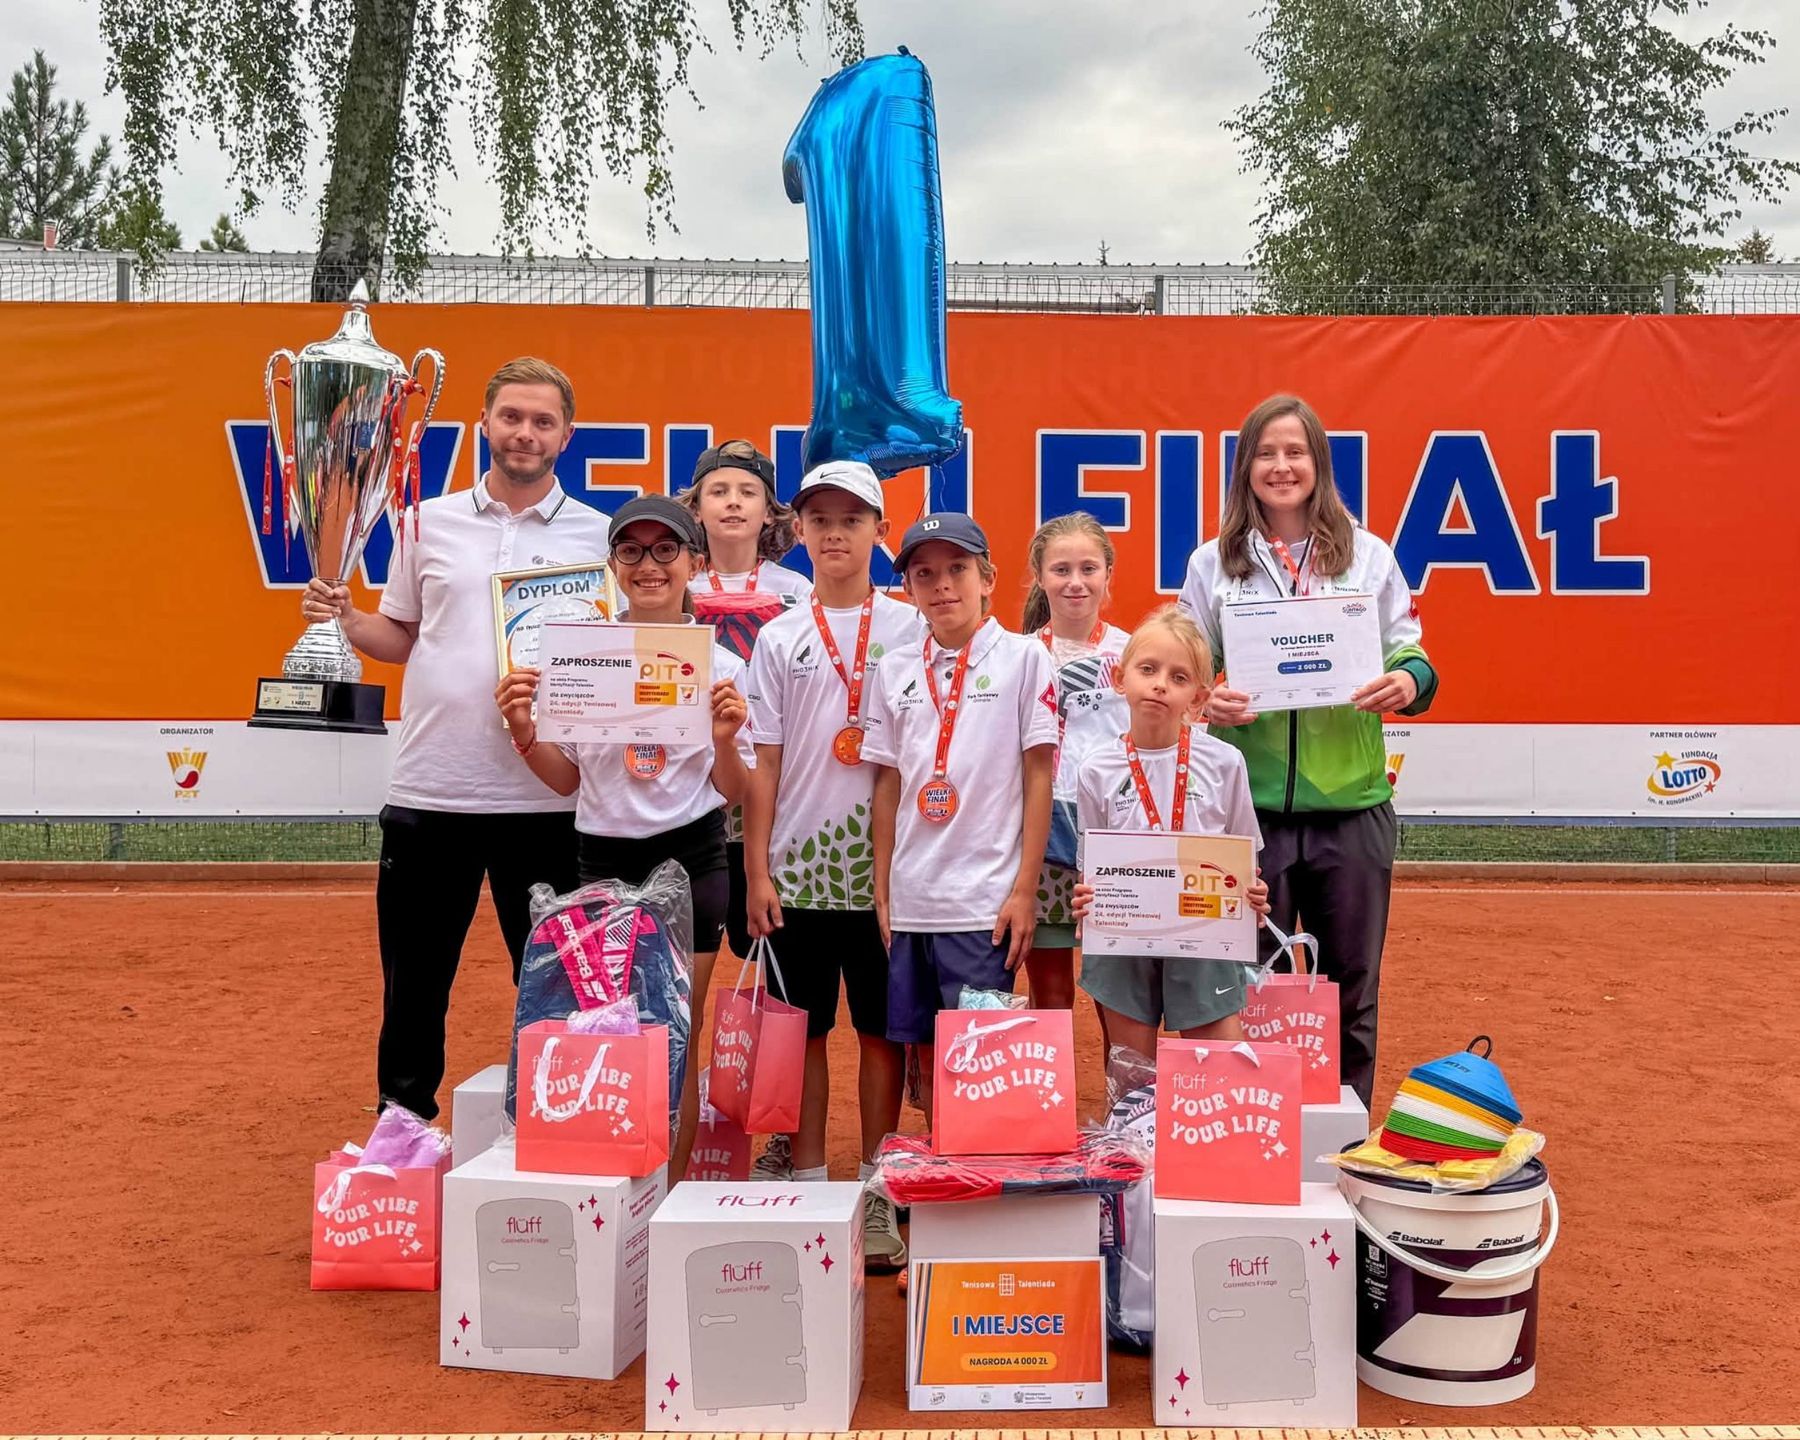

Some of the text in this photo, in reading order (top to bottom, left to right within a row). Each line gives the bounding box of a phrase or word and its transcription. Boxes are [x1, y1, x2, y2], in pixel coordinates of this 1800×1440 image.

[226, 420, 973, 592] WEI
[517, 580, 590, 600] DYPLOM
[1271, 633, 1335, 647] VOUCHER
[551, 657, 632, 668] ZAPROSZENIE
[640, 663, 677, 680] PIT
[1681, 750, 1718, 760] FUNDACJA
[1662, 766, 1707, 789] LOTTO
[926, 788, 951, 797] WIELKI
[1095, 866, 1176, 878] ZAPROSZENIE
[1184, 874, 1221, 892] PIT
[1240, 1012, 1326, 1039] YOUR VIBE
[716, 1025, 753, 1053] YOUR VIBE
[713, 1047, 748, 1075] YOUR LIFE
[954, 1042, 1057, 1074] YOUR VIBE
[530, 1067, 632, 1097] OUR IBE
[954, 1068, 1057, 1101] YOUR LIFE
[585, 1093, 630, 1116] LIFE
[1171, 1087, 1284, 1117] YOUR VIBE
[1170, 1114, 1281, 1145] YOUR LIFE
[691, 1148, 732, 1165] VIBE
[324, 1197, 419, 1224] YOUR VIBE
[323, 1220, 418, 1248] YOUR LIFE
[1401, 1234, 1445, 1246] Babolat
[1492, 1234, 1525, 1247] Babolat
[715, 1283, 771, 1295] Cosmetics Fridge
[961, 1280, 1056, 1289] Tenisowa Talentiada
[1222, 1279, 1278, 1289] Cosmetics Fridge
[953, 1314, 1065, 1336] I MIEJSCE
[969, 1357, 1013, 1366] NAGRODA
[1020, 1356, 1038, 1365] 000
[1038, 1356, 1049, 1365] ZŁ
